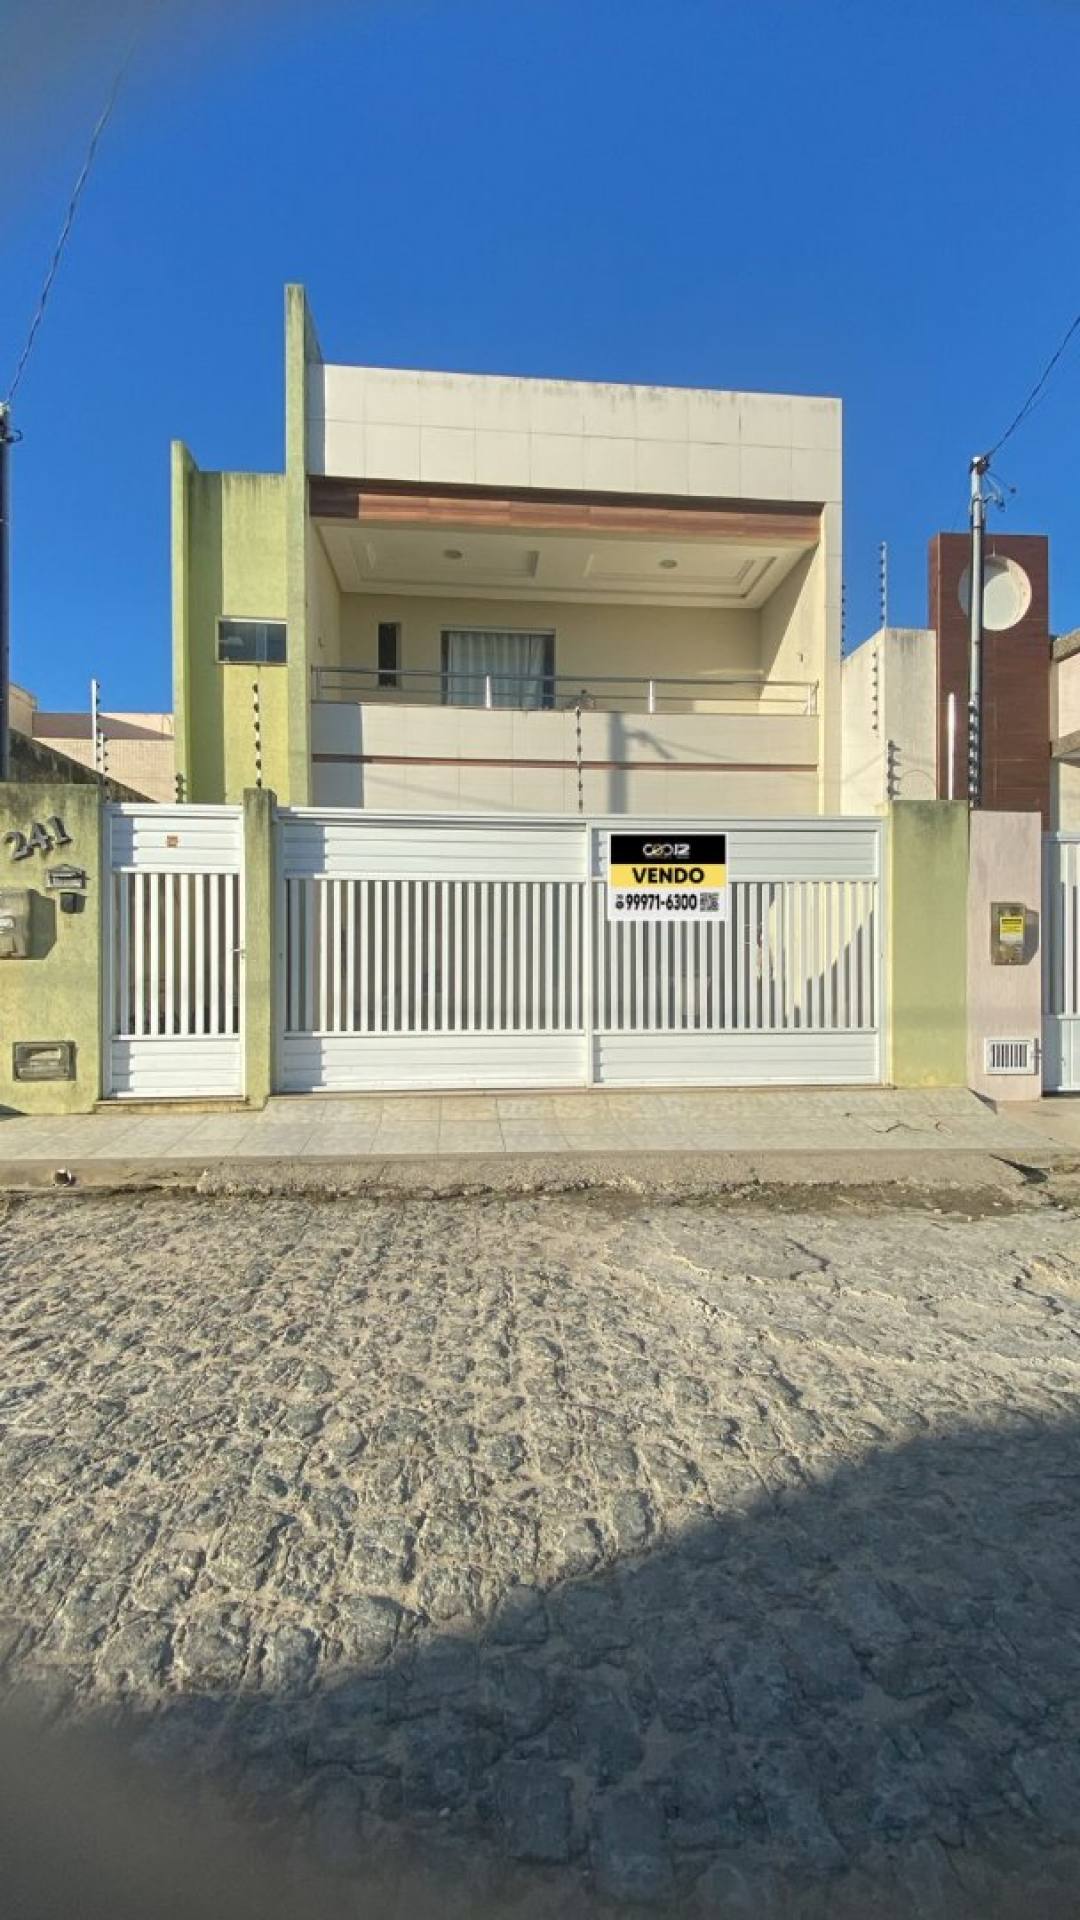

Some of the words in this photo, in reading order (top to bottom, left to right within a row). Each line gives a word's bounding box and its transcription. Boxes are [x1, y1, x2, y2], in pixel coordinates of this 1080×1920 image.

[4, 815, 72, 861] 241
[632, 867, 705, 884] VENDO
[626, 893, 697, 911] 99971-6300
